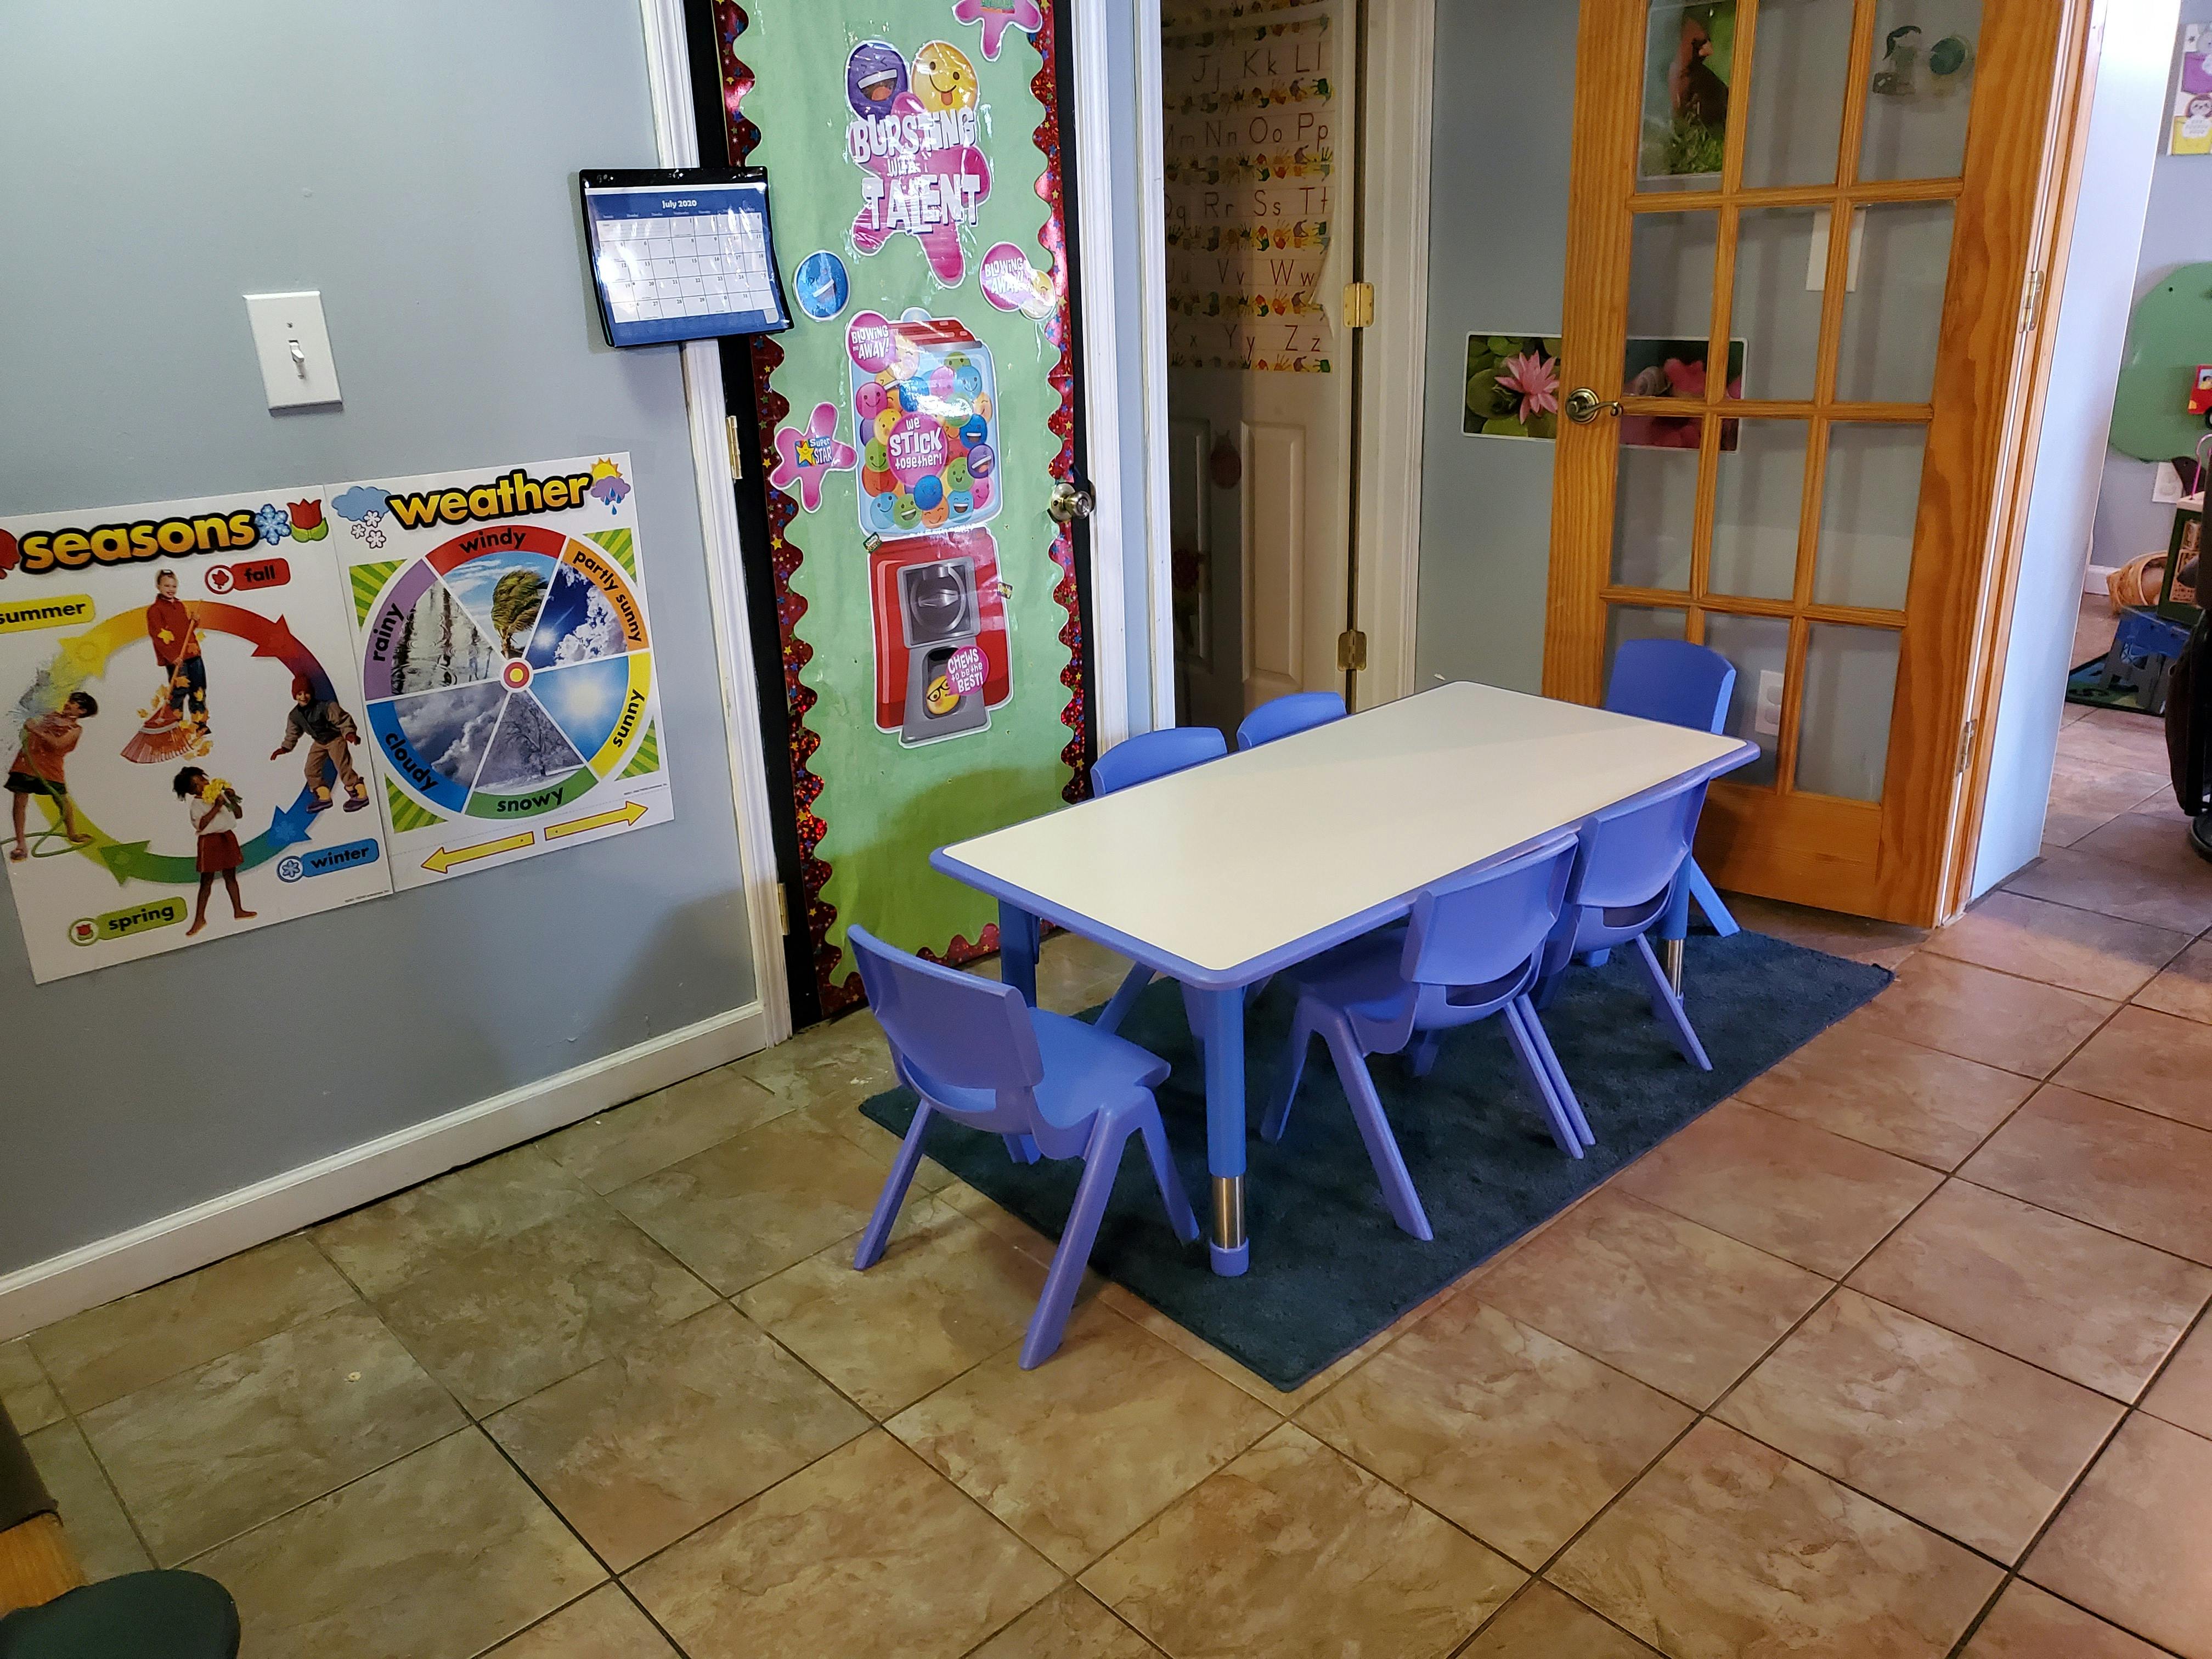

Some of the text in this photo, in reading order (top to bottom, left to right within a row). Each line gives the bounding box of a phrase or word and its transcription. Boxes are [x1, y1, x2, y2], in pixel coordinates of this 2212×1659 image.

[1243, 48, 1277, 78] Kk
[854, 108, 977, 163] BURSTING
[1206, 120, 1237, 148] Nn
[1249, 116, 1283, 144] Oo
[1297, 112, 1329, 153] Pp
[662, 199, 677, 209] July
[862, 174, 981, 234] TALENT
[1205, 191, 1235, 218] Rr
[1253, 189, 1282, 217] Ss
[1298, 187, 1328, 215] Tt
[985, 257, 1024, 278] BLOWING
[1270, 259, 1315, 286] Ww
[851, 325, 889, 345] BLOWING
[858, 337, 889, 360] AWAY!
[905, 417, 921, 431] we
[889, 426, 943, 457] STICK
[814, 446, 832, 465] STAR
[895, 453, 943, 471] together!
[388, 471, 591, 528] weather
[21, 512, 257, 572] seasons
[459, 528, 526, 554] windy
[244, 564, 275, 582] fall
[573, 550, 643, 643] partly sunny
[0, 603, 86, 625] summer
[372, 602, 405, 663] rainy
[947, 648, 979, 674] CHEWS
[951, 662, 983, 682] to be the
[957, 671, 984, 693] BEST!
[612, 689, 647, 748] sunny
[385, 731, 438, 792] cloudy
[496, 786, 565, 813] snowy
[309, 845, 370, 869] winter
[108, 905, 174, 932] spring
